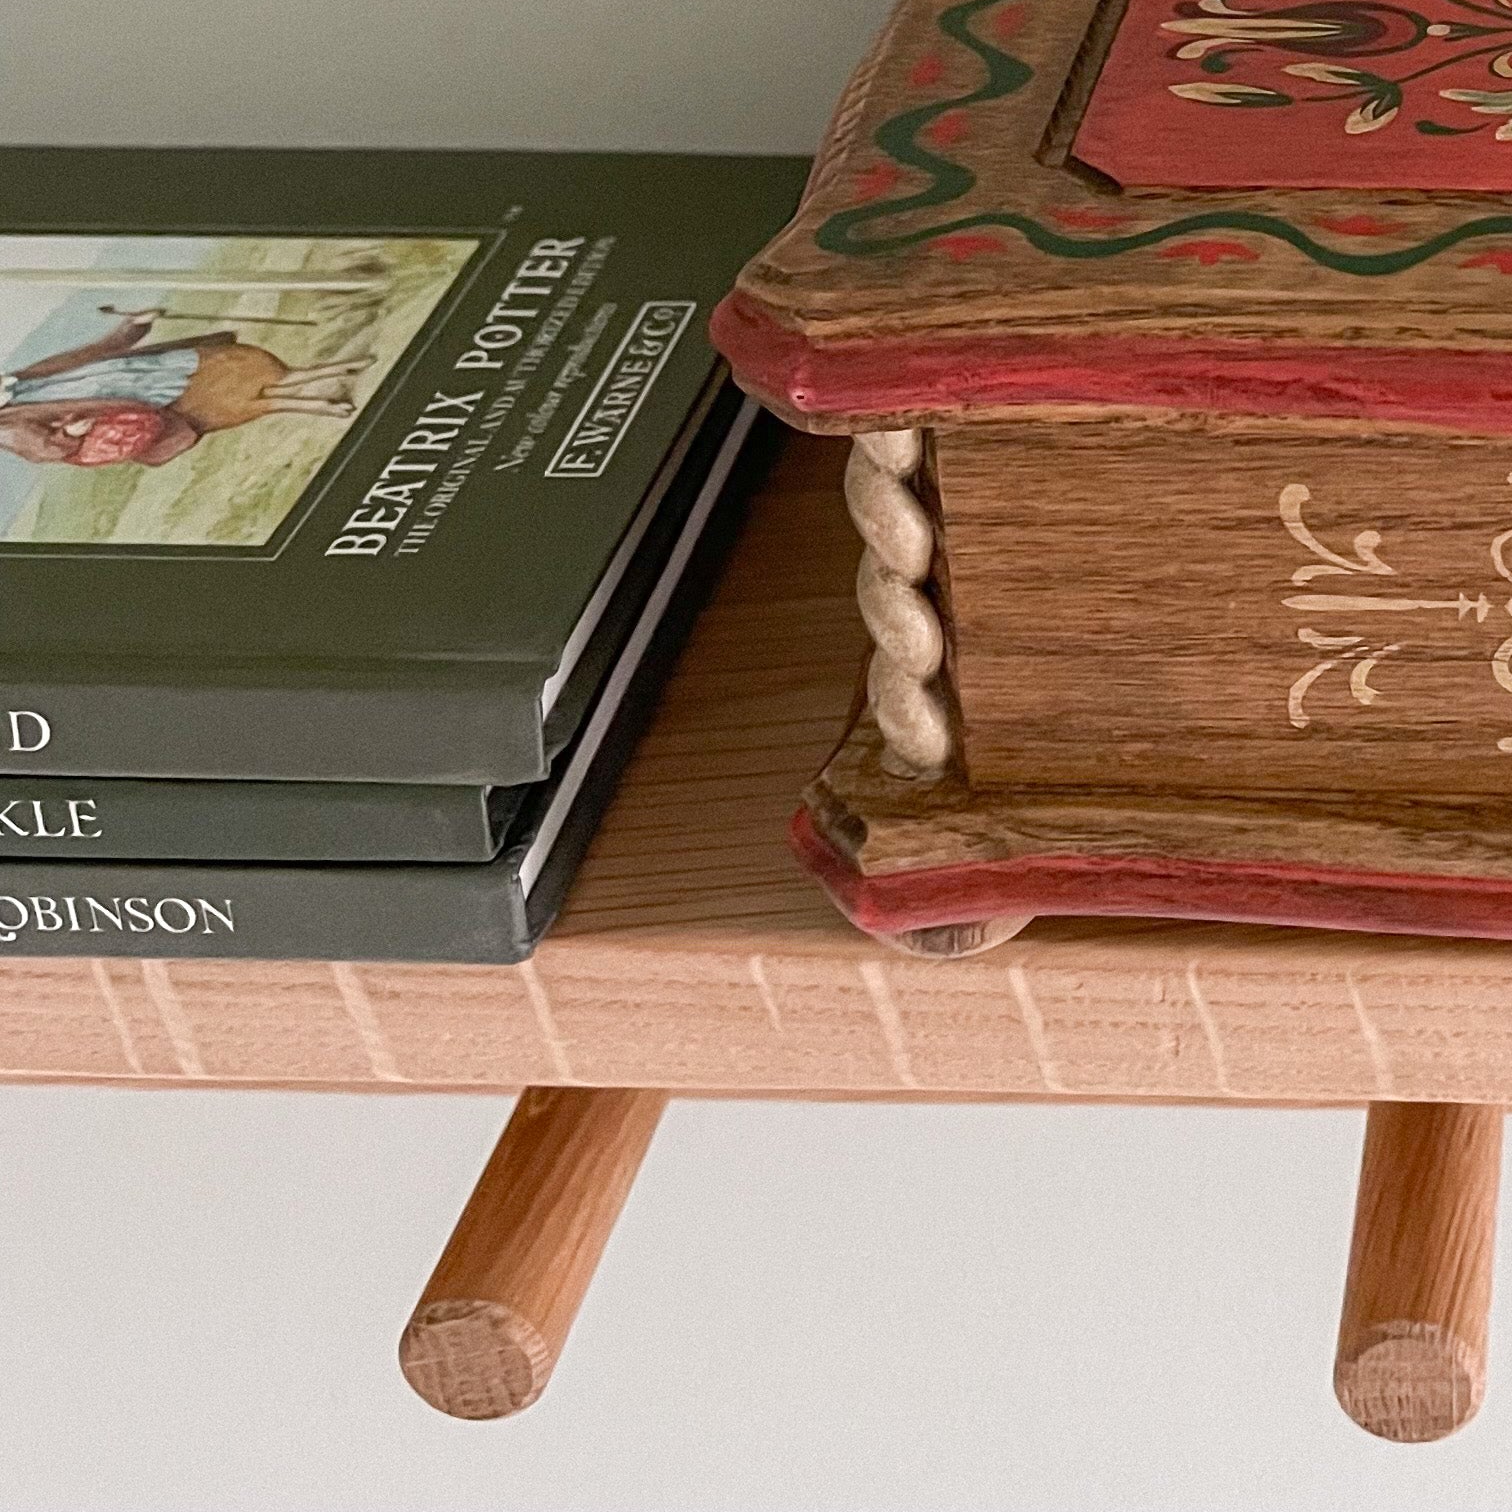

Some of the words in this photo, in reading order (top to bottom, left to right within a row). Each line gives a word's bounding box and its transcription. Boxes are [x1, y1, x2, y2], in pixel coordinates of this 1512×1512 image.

[324, 390, 485, 557] BEATRIX
[454, 236, 585, 369] POTTER
[393, 518, 439, 557] THE
[424, 433, 494, 517] ORIGINAL
[479, 395, 516, 433] AND
[0, 895, 236, 942] OBINSON
